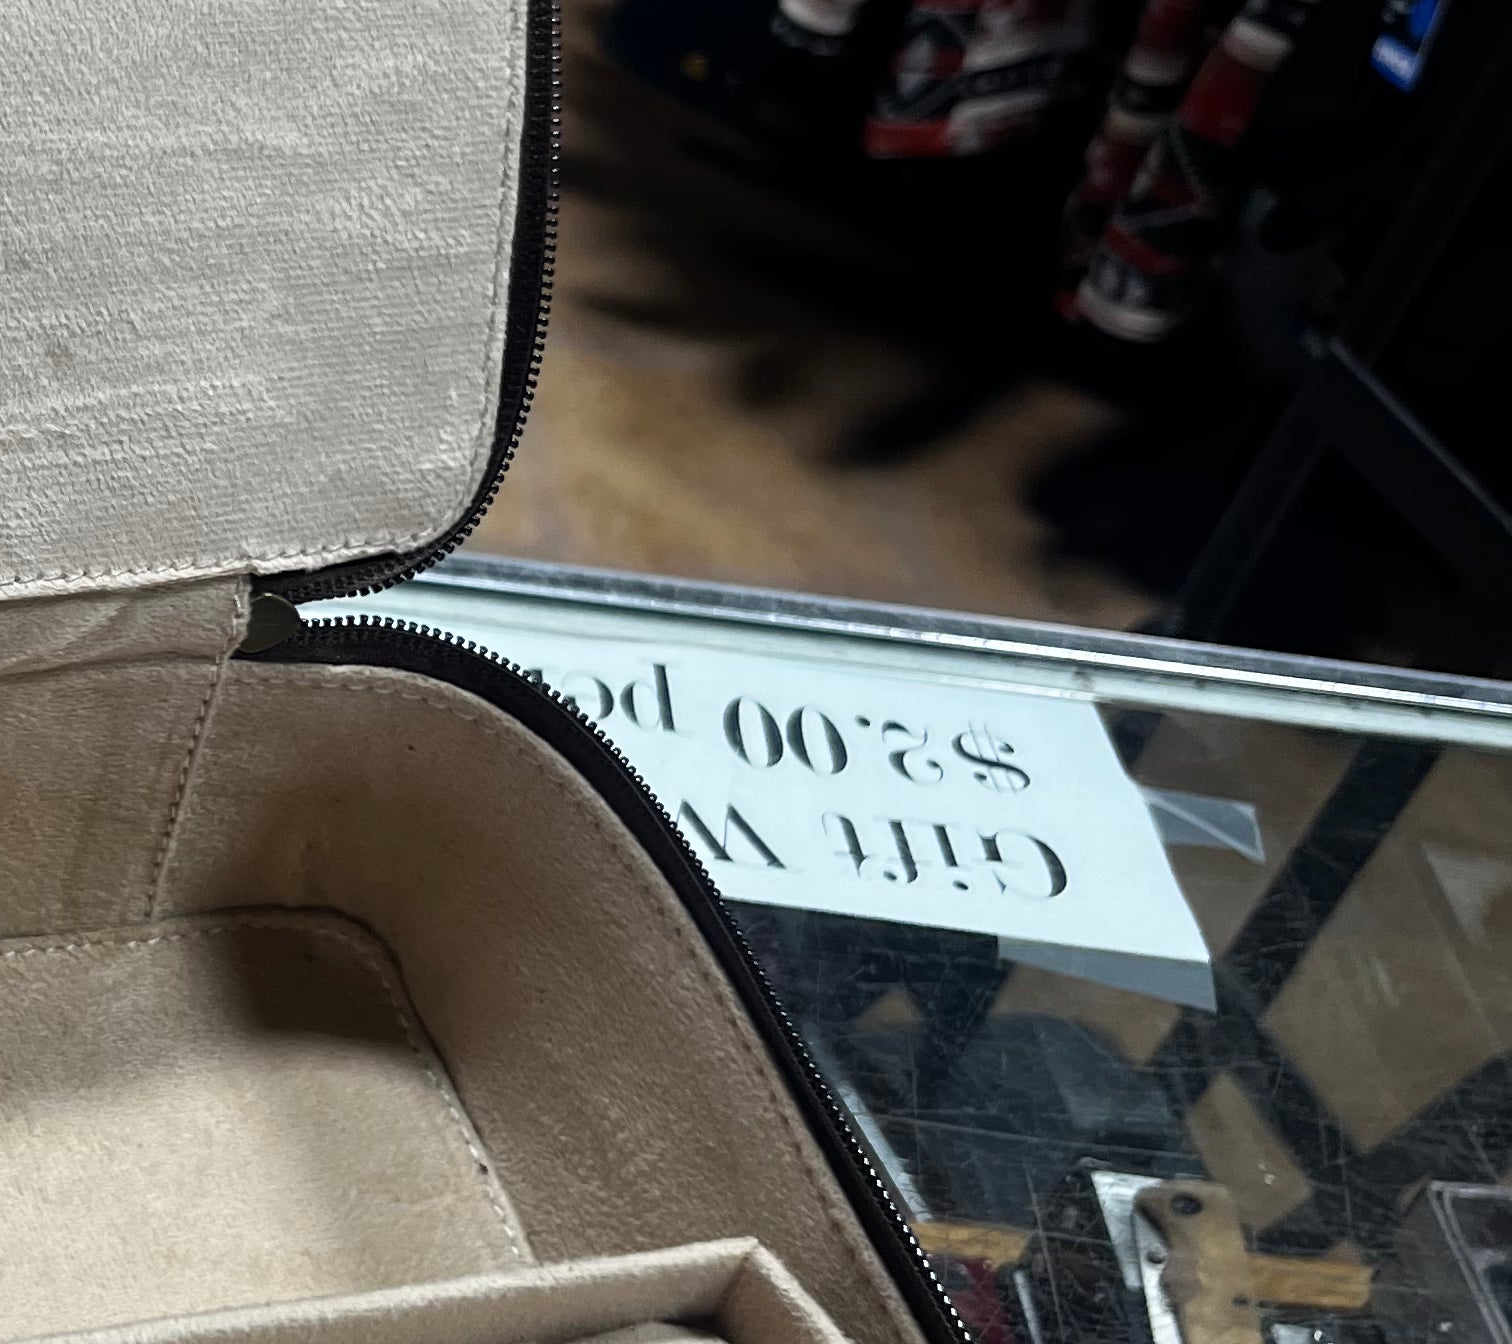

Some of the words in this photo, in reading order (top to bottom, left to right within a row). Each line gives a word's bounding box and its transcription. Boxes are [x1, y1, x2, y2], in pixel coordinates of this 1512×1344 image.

[530, 663, 677, 733] pe
[722, 694, 1031, 794] $2.00
[822, 810, 1069, 900] Gift
